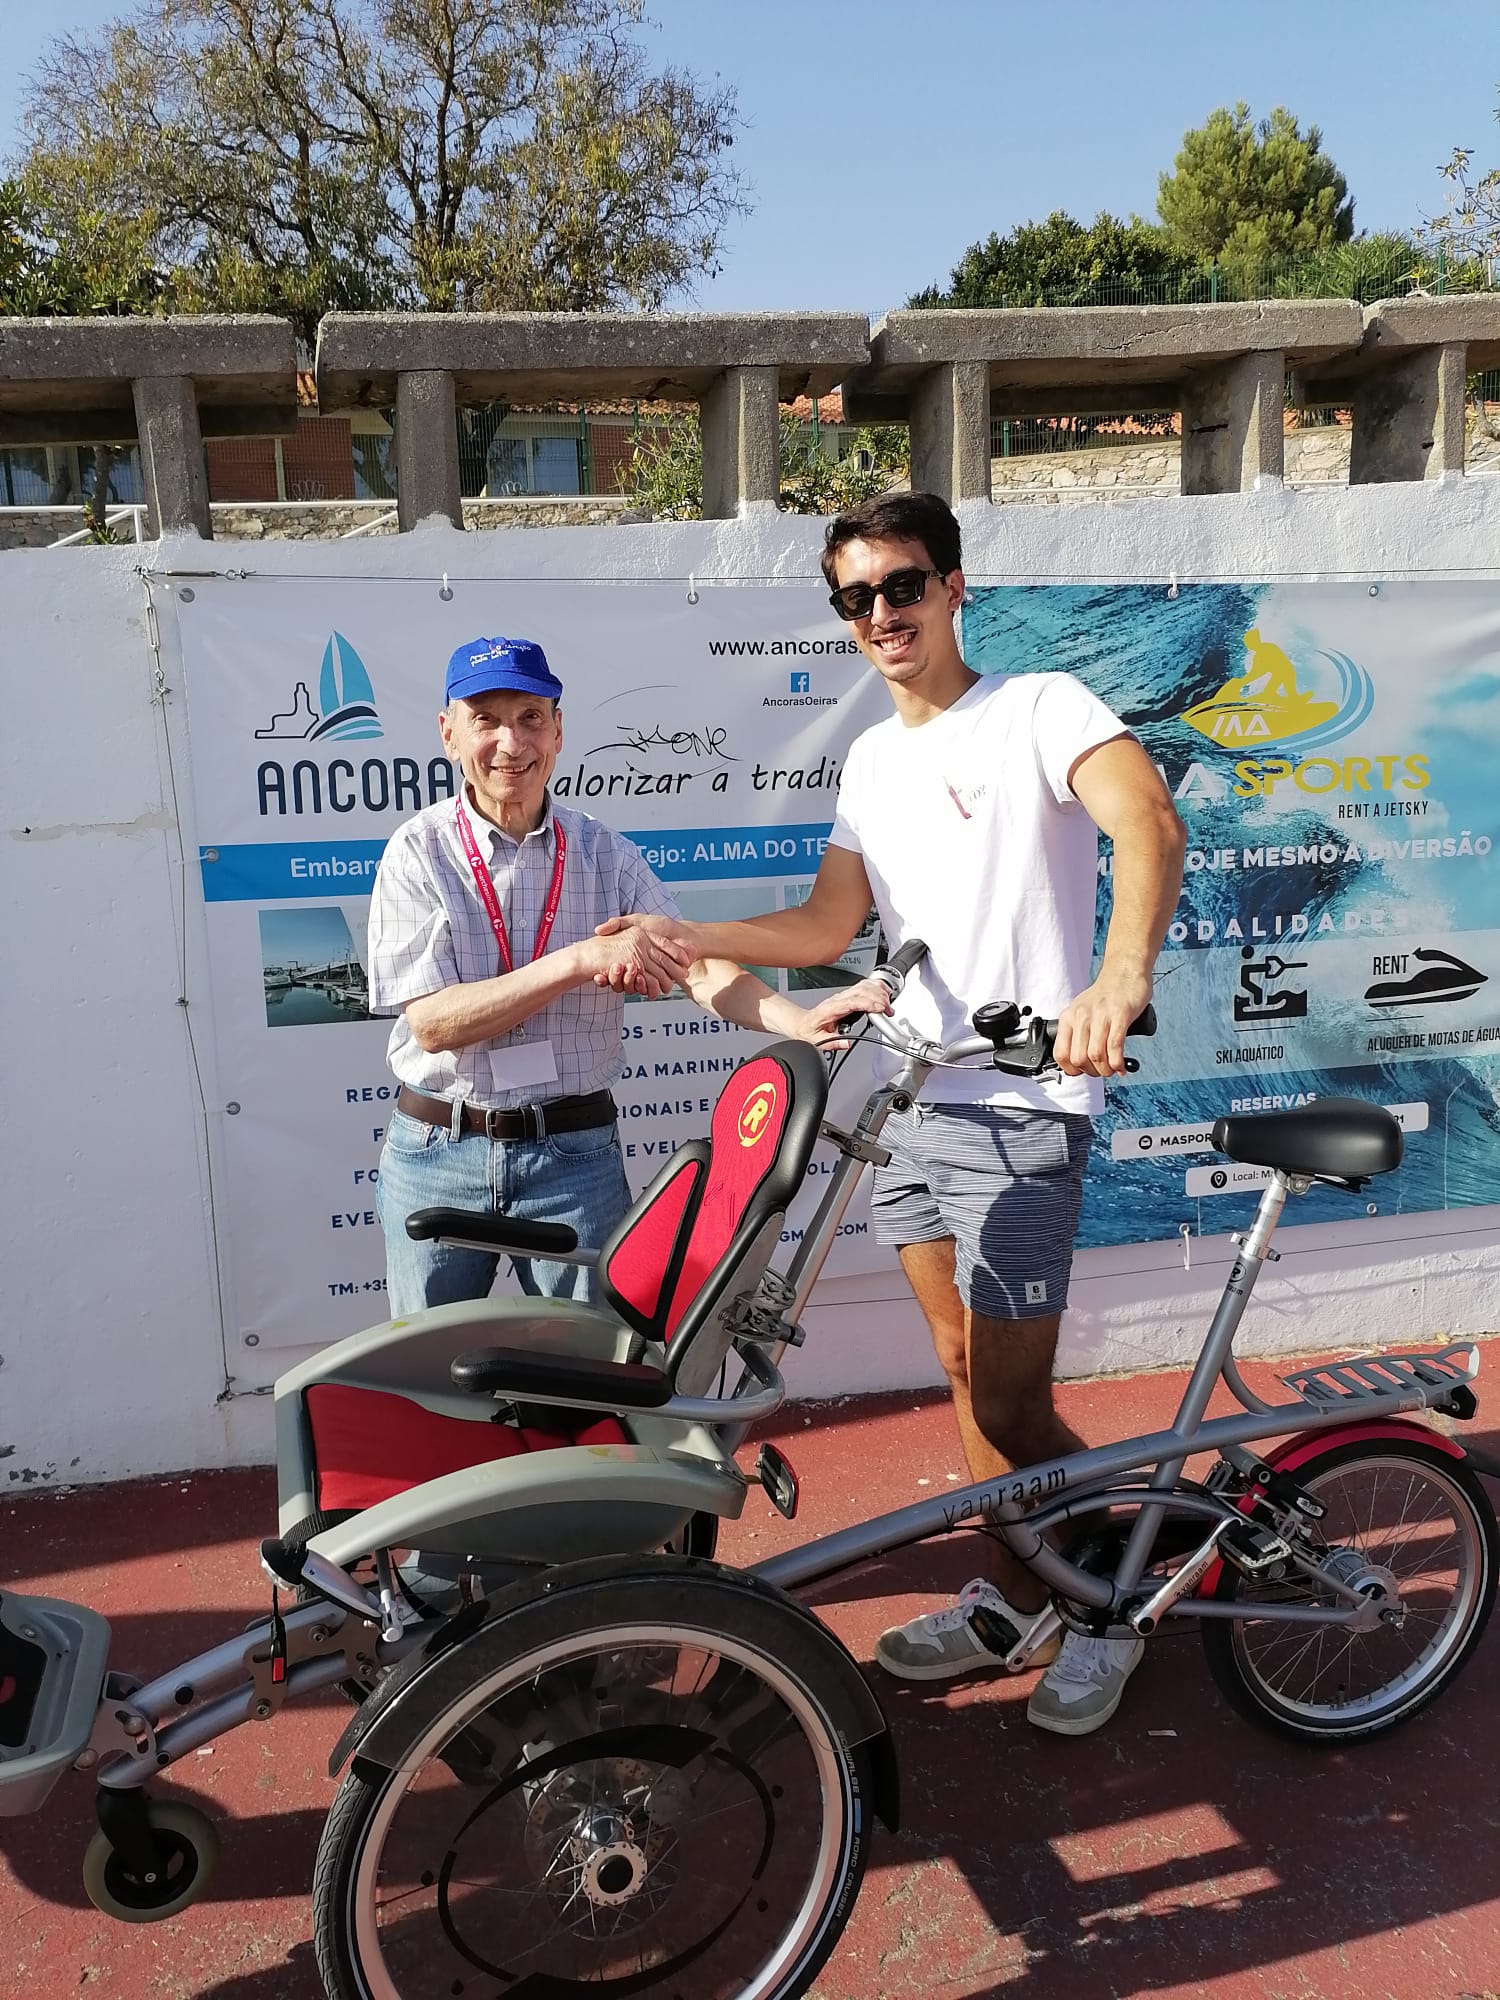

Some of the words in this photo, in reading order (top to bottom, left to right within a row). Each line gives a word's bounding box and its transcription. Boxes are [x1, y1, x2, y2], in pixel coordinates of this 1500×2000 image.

[762, 697, 838, 707] AncorasOeiras
[258, 757, 465, 816] ANCORA
[547, 764, 692, 797] alorizar
[712, 773, 729, 793] a
[1232, 754, 1431, 798] SPORTS
[1338, 804, 1369, 819] RENT
[1373, 803, 1380, 817] A
[1384, 801, 1429, 817] JETSKY
[693, 842, 758, 863] ALMA
[764, 838, 797, 859] DO
[1243, 842, 1338, 869] MESMO
[1342, 842, 1362, 863] A
[1367, 830, 1492, 861] DIVERSÃO
[476, 869, 496, 917] marchesini.com
[1373, 955, 1409, 976] RENT
[662, 1015, 751, 1037] TURÍSTI
[1367, 1035, 1411, 1052] ALUGUER
[1413, 1034, 1426, 1048] DE
[1428, 1030, 1460, 1047] MOTAS
[1462, 1029, 1475, 1044] DE
[1476, 1025, 1500, 1042] ÁGUA
[1216, 1050, 1233, 1065] SKI
[1235, 1045, 1284, 1064] AQUÁTICO
[617, 1100, 693, 1119] IONAIS
[700, 1099, 709, 1112] E
[627, 1144, 636, 1158] E
[1233, 1170, 1259, 1181] Local:
[331, 1211, 382, 1229] EVE
[328, 1282, 359, 1297] TM:
[942, 1467, 1066, 1526] vanraam
